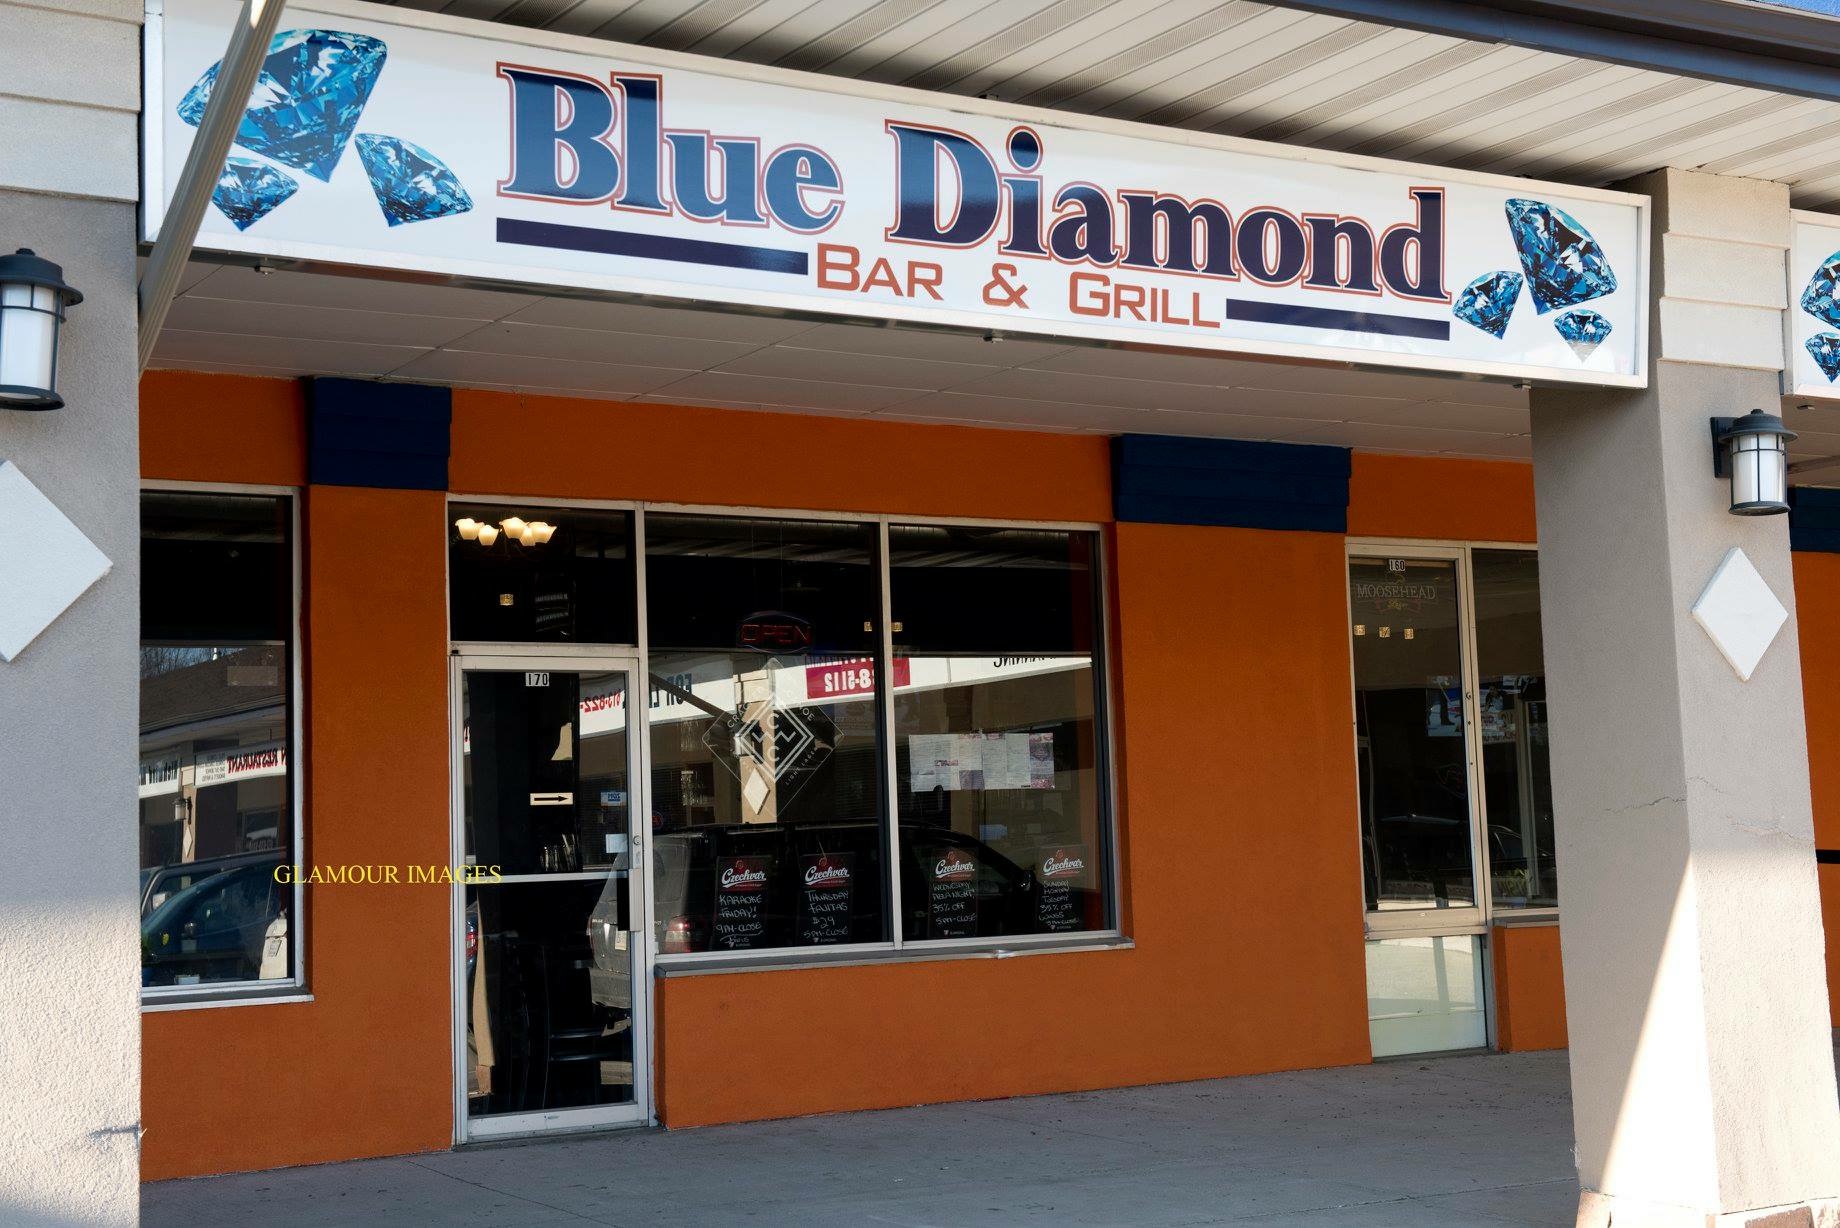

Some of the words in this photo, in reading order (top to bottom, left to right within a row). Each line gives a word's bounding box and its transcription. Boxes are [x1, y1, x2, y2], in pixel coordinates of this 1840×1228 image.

[496, 61, 845, 235] Blue
[885, 119, 1452, 305] Diamond
[817, 242, 944, 301] BAR
[982, 262, 1029, 310] &
[1069, 271, 1221, 329] GRILL
[1356, 584, 1437, 600] MOOSEHEAD
[740, 623, 811, 644] OPEN
[528, 673, 548, 686] 170
[719, 894, 762, 906] KARAOKE
